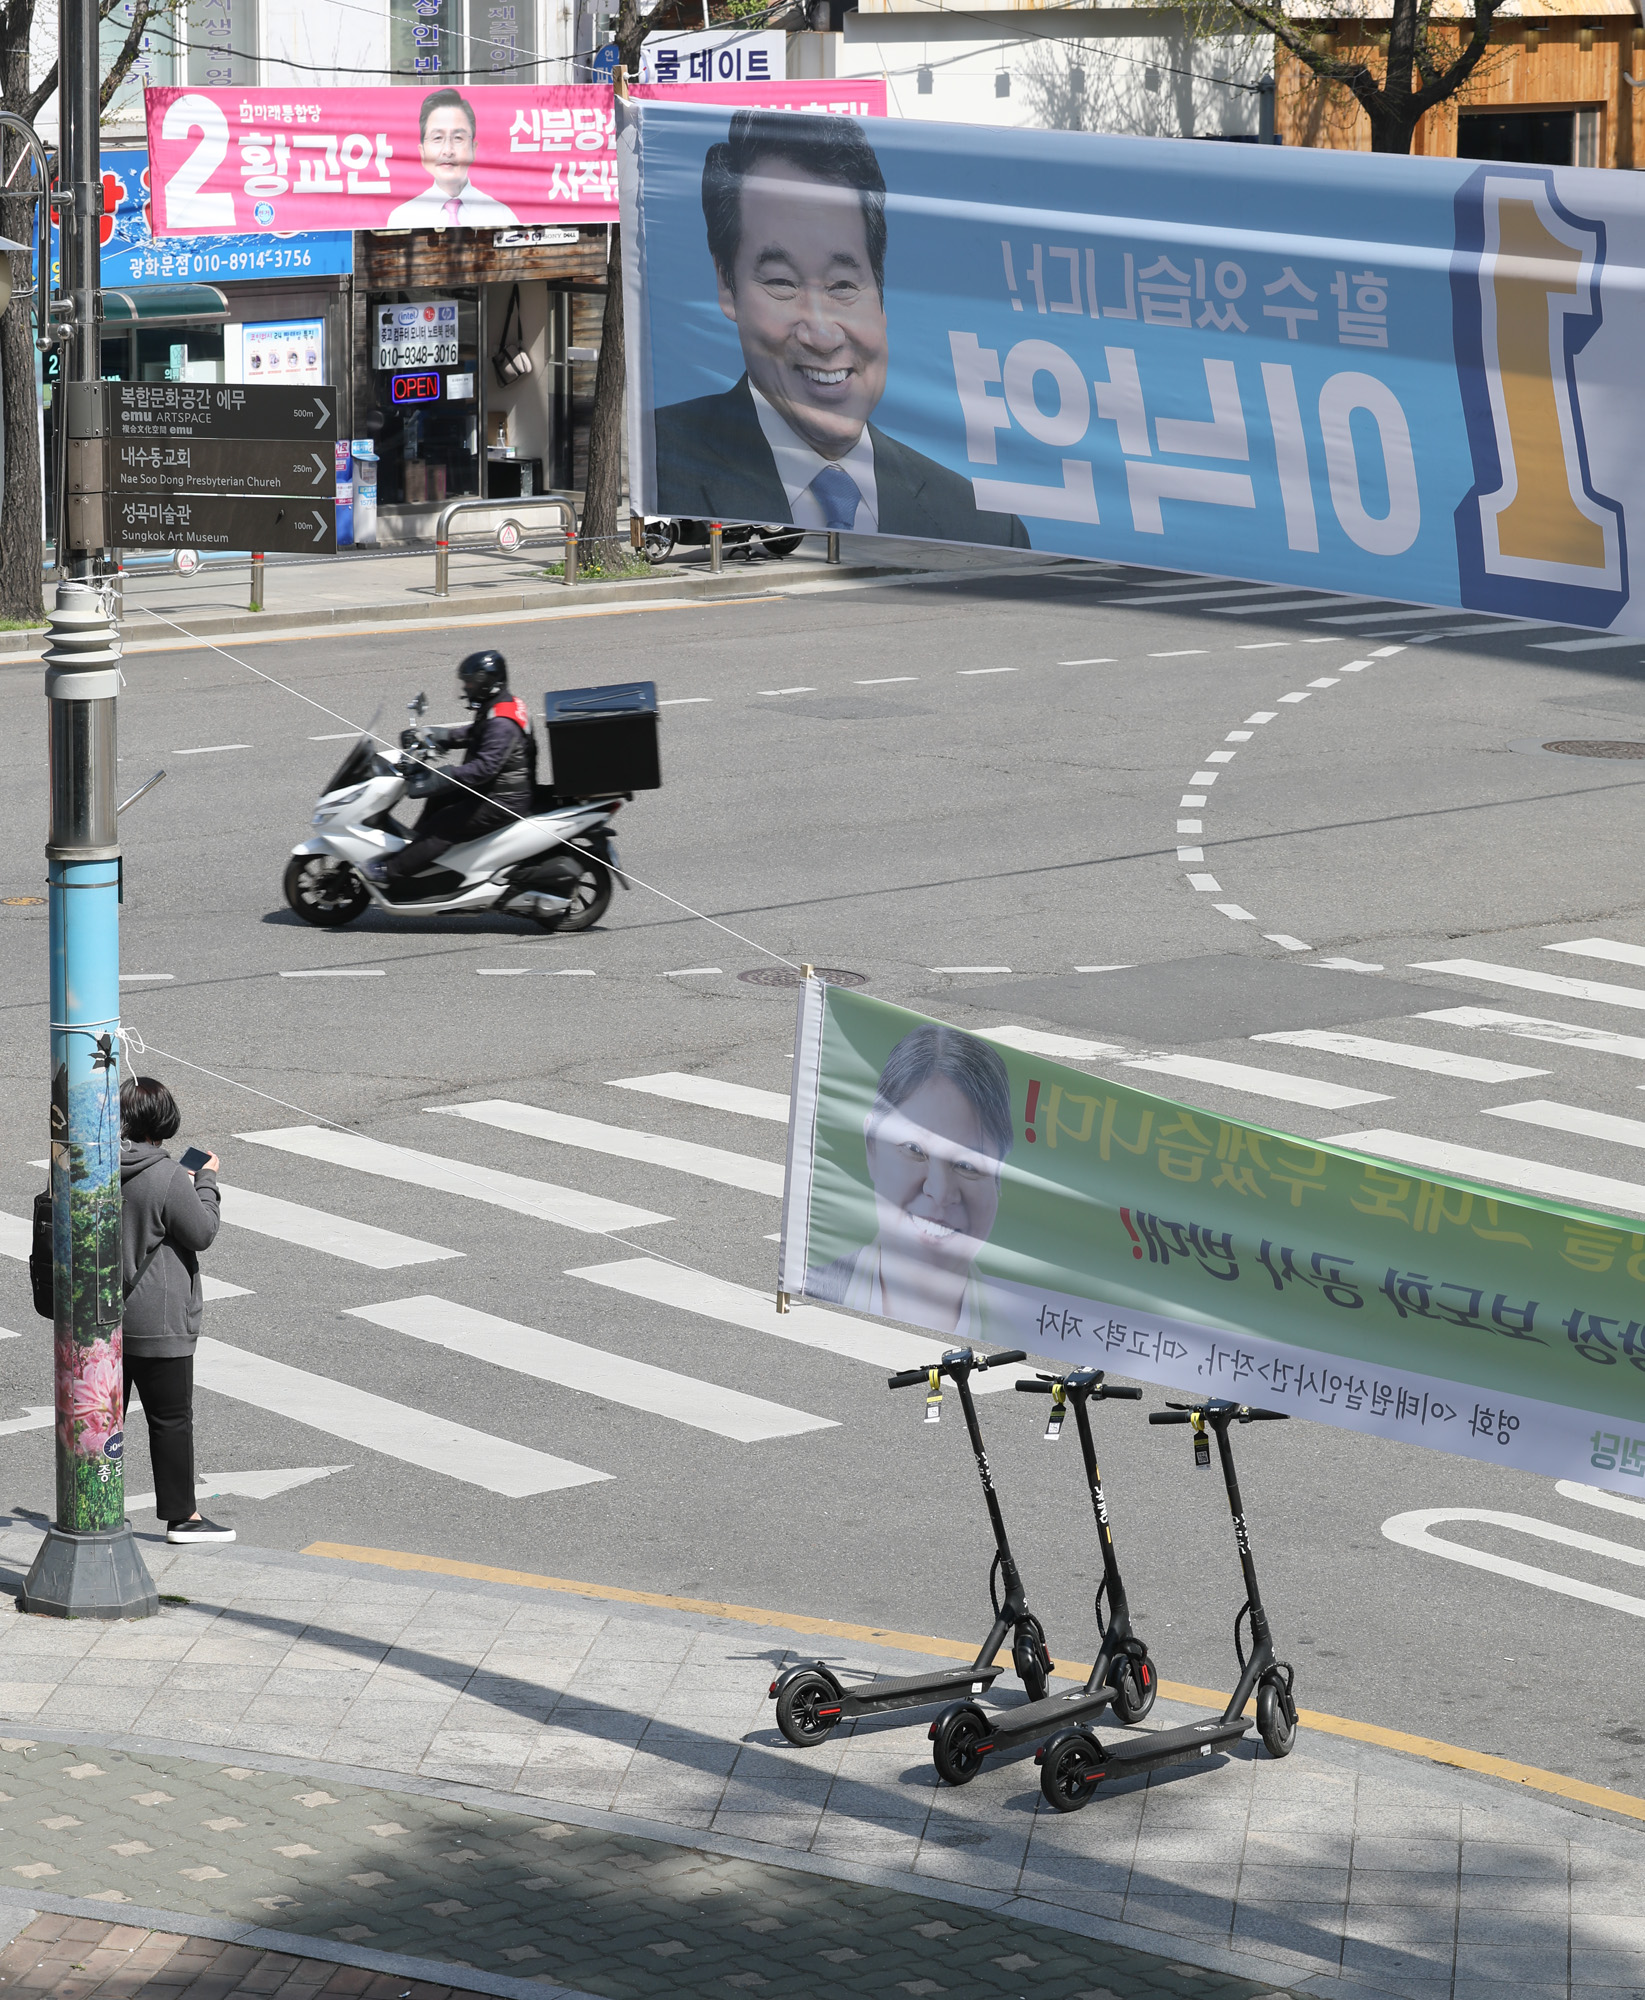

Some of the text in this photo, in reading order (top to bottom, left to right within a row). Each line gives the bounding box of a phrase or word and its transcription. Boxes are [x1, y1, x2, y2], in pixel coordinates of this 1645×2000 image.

[690, 50, 770, 82] 데이트
[254, 104, 322, 123] 미래통합당
[162, 94, 236, 228] 2
[238, 133, 393, 197] 황교안
[130, 249, 312, 279] 광화문점 010-8914-3756
[411, 325, 426, 340] 모니터
[428, 324, 443, 339] 노트북
[380, 344, 457, 367] 010-9348-3016
[394, 377, 437, 399] OPEN
[121, 387, 246, 410] 복합문화공간 에무
[121, 411, 212, 424] emu ARTSPACE
[293, 410, 314, 418] 500m
[170, 425, 192, 435] emu
[121, 447, 191, 468] 내수동교회
[293, 465, 312, 473] 250m
[120, 473, 138, 484] Nae
[140, 473, 158, 485] Soo
[160, 474, 184, 488] Dong
[186, 475, 245, 488] Presbyterian
[122, 503, 191, 525] 성곡미술관
[294, 522, 313, 530] 100m
[122, 530, 229, 543] Sungkok Art Museum
